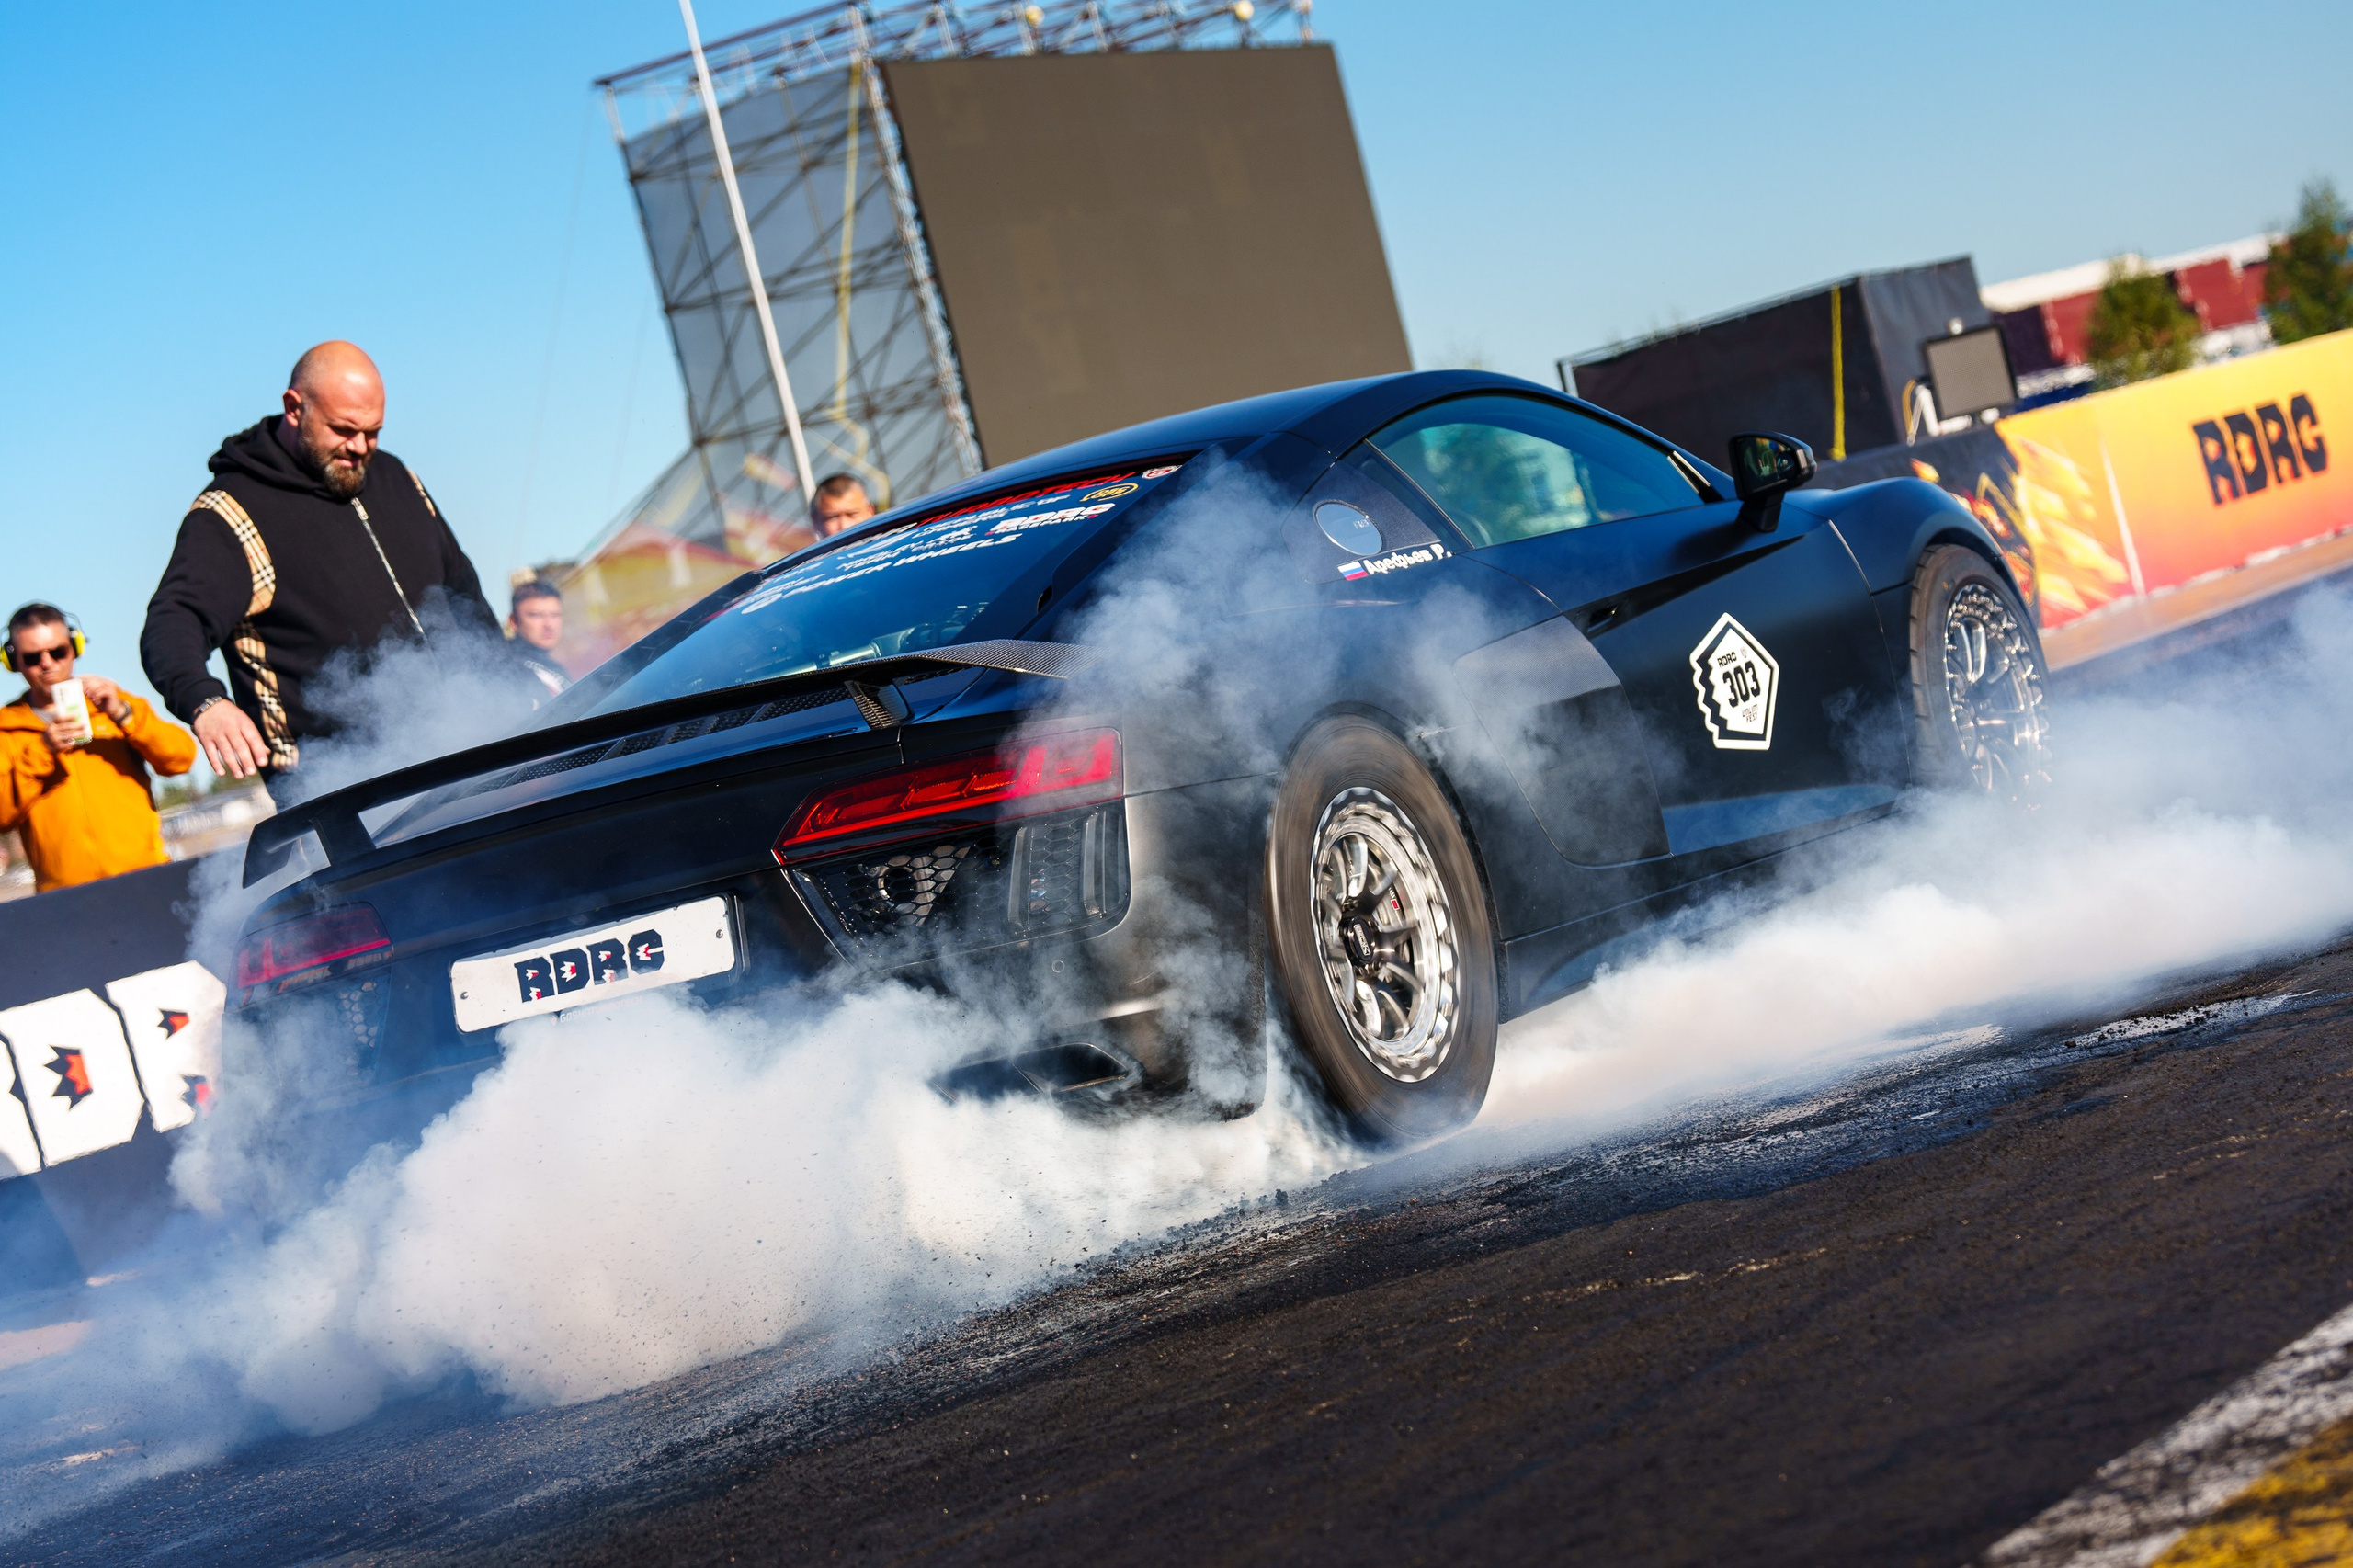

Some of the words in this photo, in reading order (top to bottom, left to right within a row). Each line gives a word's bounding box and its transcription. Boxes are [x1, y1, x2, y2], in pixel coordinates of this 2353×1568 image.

[2192, 392, 2329, 506] RDRC
[914, 472, 1136, 528] TURBOTECH
[991, 502, 1116, 531] RDRC
[892, 533, 1023, 567] WHEELS
[1362, 549, 1433, 574] Арефьев
[1429, 543, 1453, 561] Р.
[1717, 651, 1737, 668] RDRC
[1722, 660, 1761, 709] 303
[513, 928, 665, 1004] RDRC
